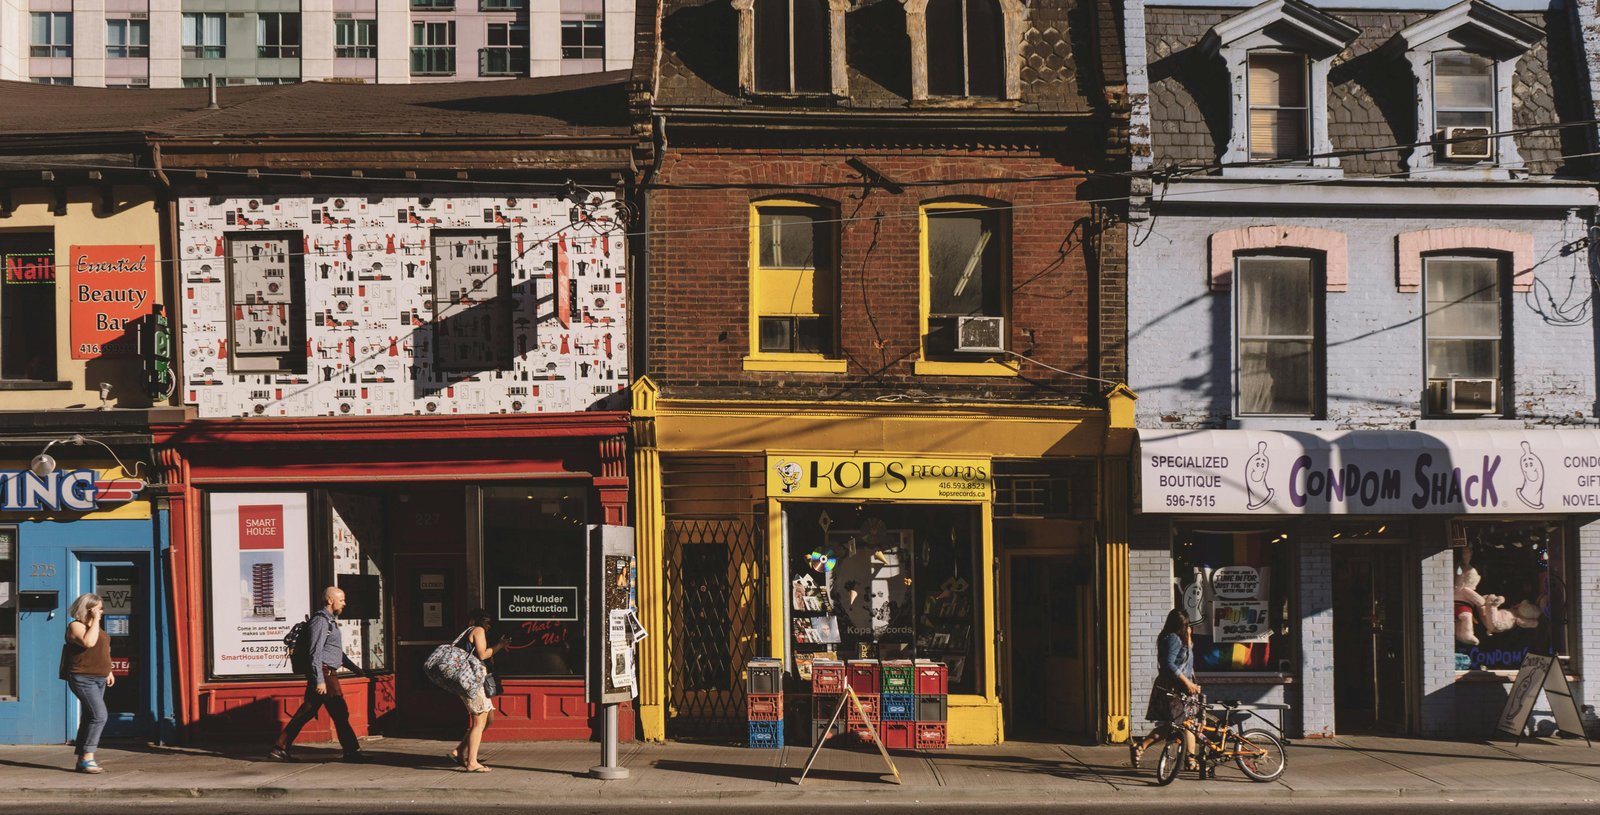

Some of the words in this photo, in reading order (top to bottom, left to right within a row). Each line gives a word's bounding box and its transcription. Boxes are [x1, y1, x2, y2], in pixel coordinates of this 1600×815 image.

[77, 255, 147, 273] Essential
[78, 285, 147, 309] Beauty
[96, 313, 129, 331] Bar
[1151, 455, 1229, 469] SPECIALIZED
[1563, 456, 1600, 468] COND
[809, 460, 907, 494] KOPS
[911, 464, 987, 482] RECORDS
[1159, 474, 1221, 489] BOUTIQUE
[0, 470, 98, 510] ING
[938, 481, 985, 490] 416.593.8523
[938, 489, 986, 498] kopsrecords.ca
[1165, 494, 1216, 507] 596-7515
[245, 518, 276, 527] SMART
[246, 527, 277, 536] HOUSE
[29, 563, 57, 577] 225
[513, 595, 533, 603] Now
[535, 594, 564, 604] Under
[508, 604, 568, 613] Construction
[521, 615, 561, 634] That's
[847, 625, 872, 636] Kops
